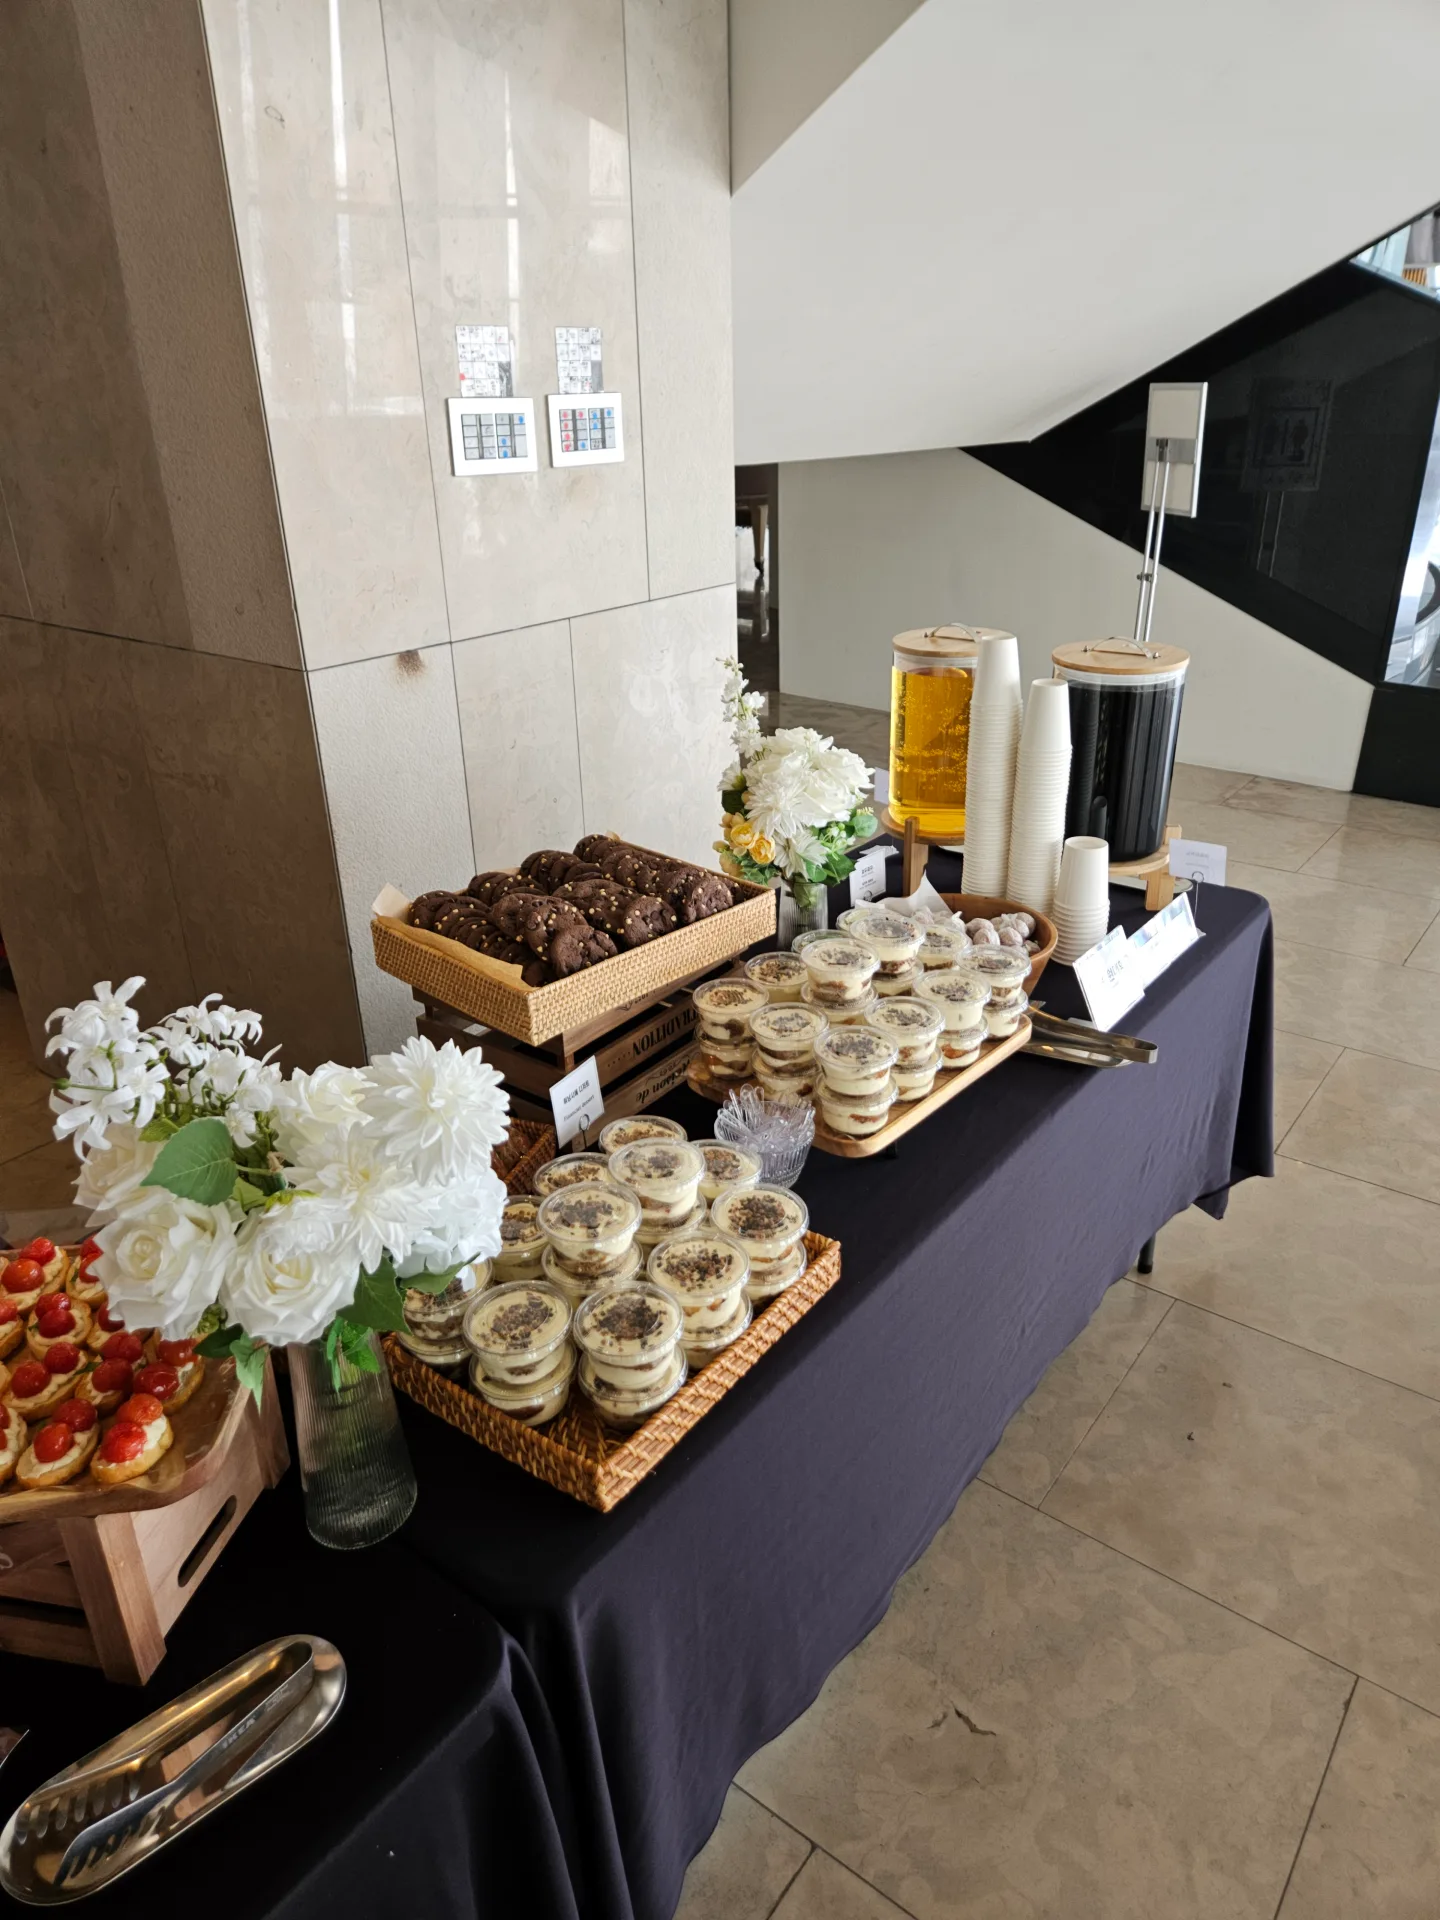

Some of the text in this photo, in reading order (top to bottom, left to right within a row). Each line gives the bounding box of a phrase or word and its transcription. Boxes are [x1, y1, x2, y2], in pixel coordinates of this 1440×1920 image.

[632, 1007, 699, 1056] TRADITION
[635, 1090, 650, 1104] de
[222, 1717, 256, 1749] IKEA
